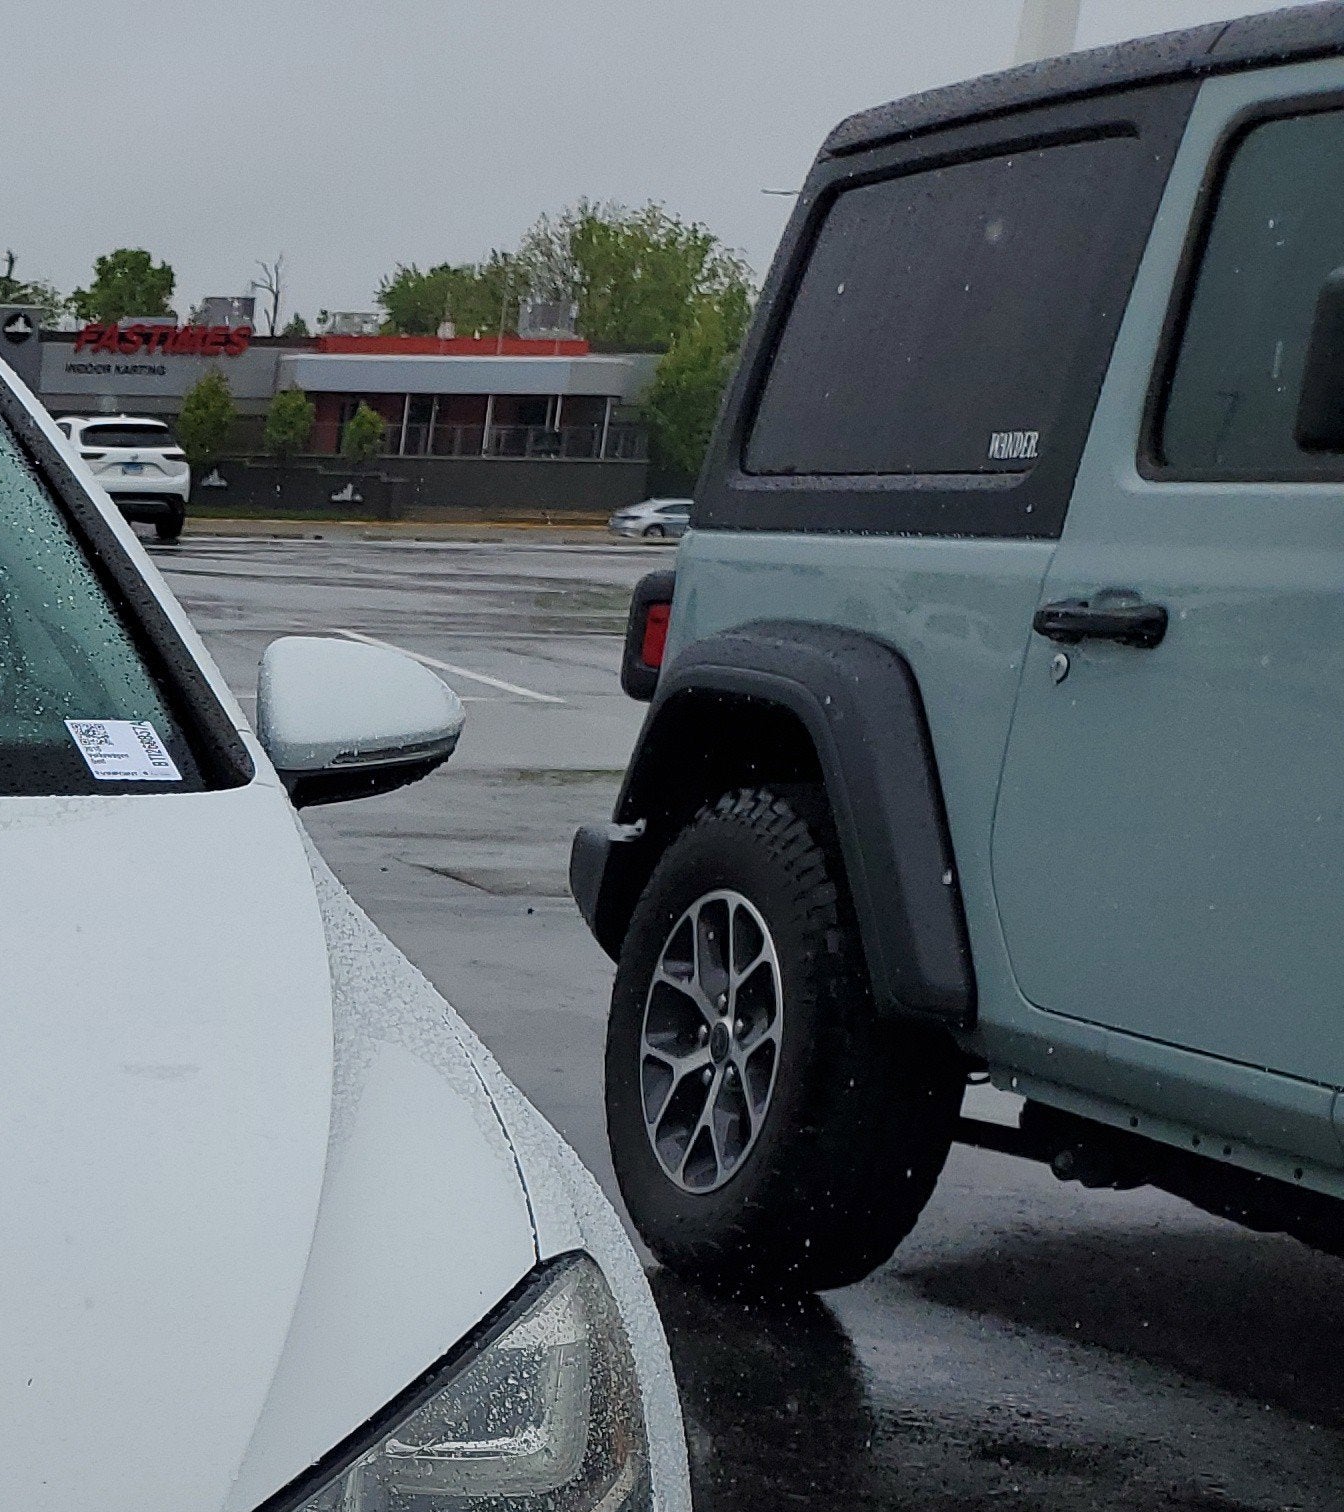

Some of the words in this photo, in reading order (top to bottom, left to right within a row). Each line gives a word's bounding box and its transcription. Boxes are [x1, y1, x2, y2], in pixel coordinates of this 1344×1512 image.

[73, 322, 253, 357] FASTIMES
[64, 361, 112, 375] INDOOR
[114, 361, 167, 376] KARTING
